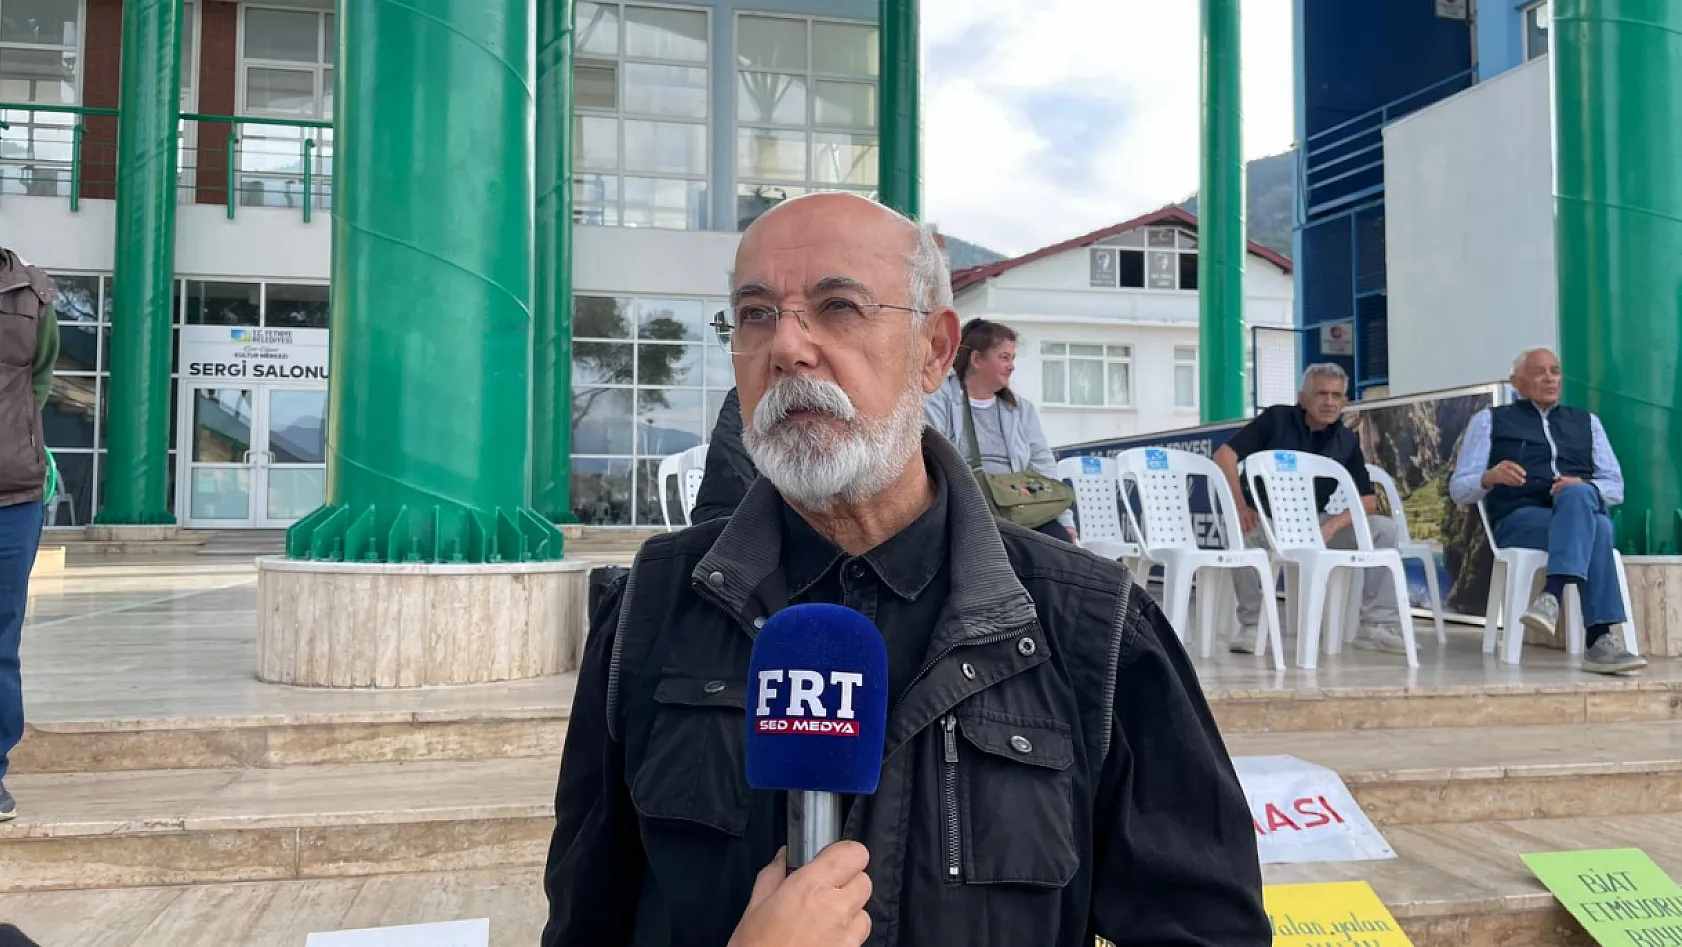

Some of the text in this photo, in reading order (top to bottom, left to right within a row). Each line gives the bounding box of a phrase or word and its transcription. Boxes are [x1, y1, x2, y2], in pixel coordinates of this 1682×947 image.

[188, 359, 247, 377] SERGİ
[756, 669, 863, 719] FRT
[759, 719, 855, 734] SED MEDYA
